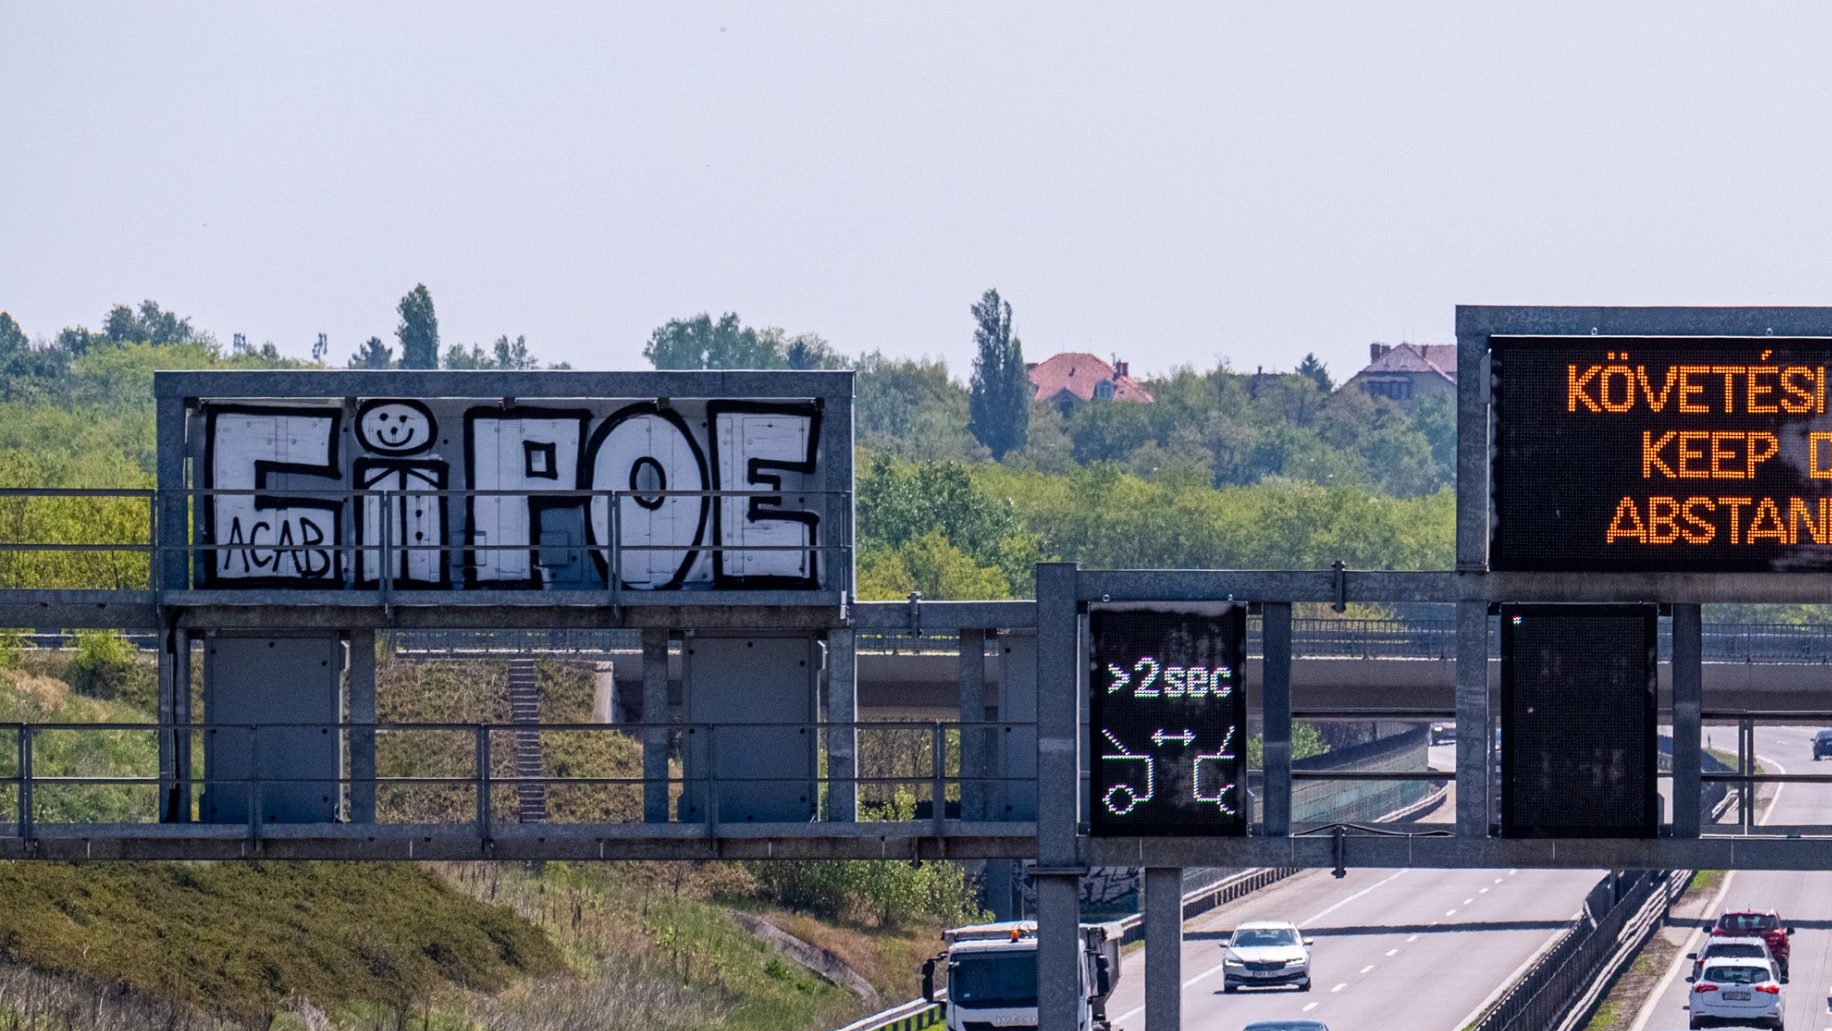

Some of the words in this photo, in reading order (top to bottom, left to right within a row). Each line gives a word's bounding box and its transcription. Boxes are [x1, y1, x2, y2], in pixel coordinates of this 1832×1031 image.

[1567, 350, 1826, 413] KÖVETÉSI
[1642, 430, 1779, 479] KEEP
[223, 516, 331, 578] ACAB
